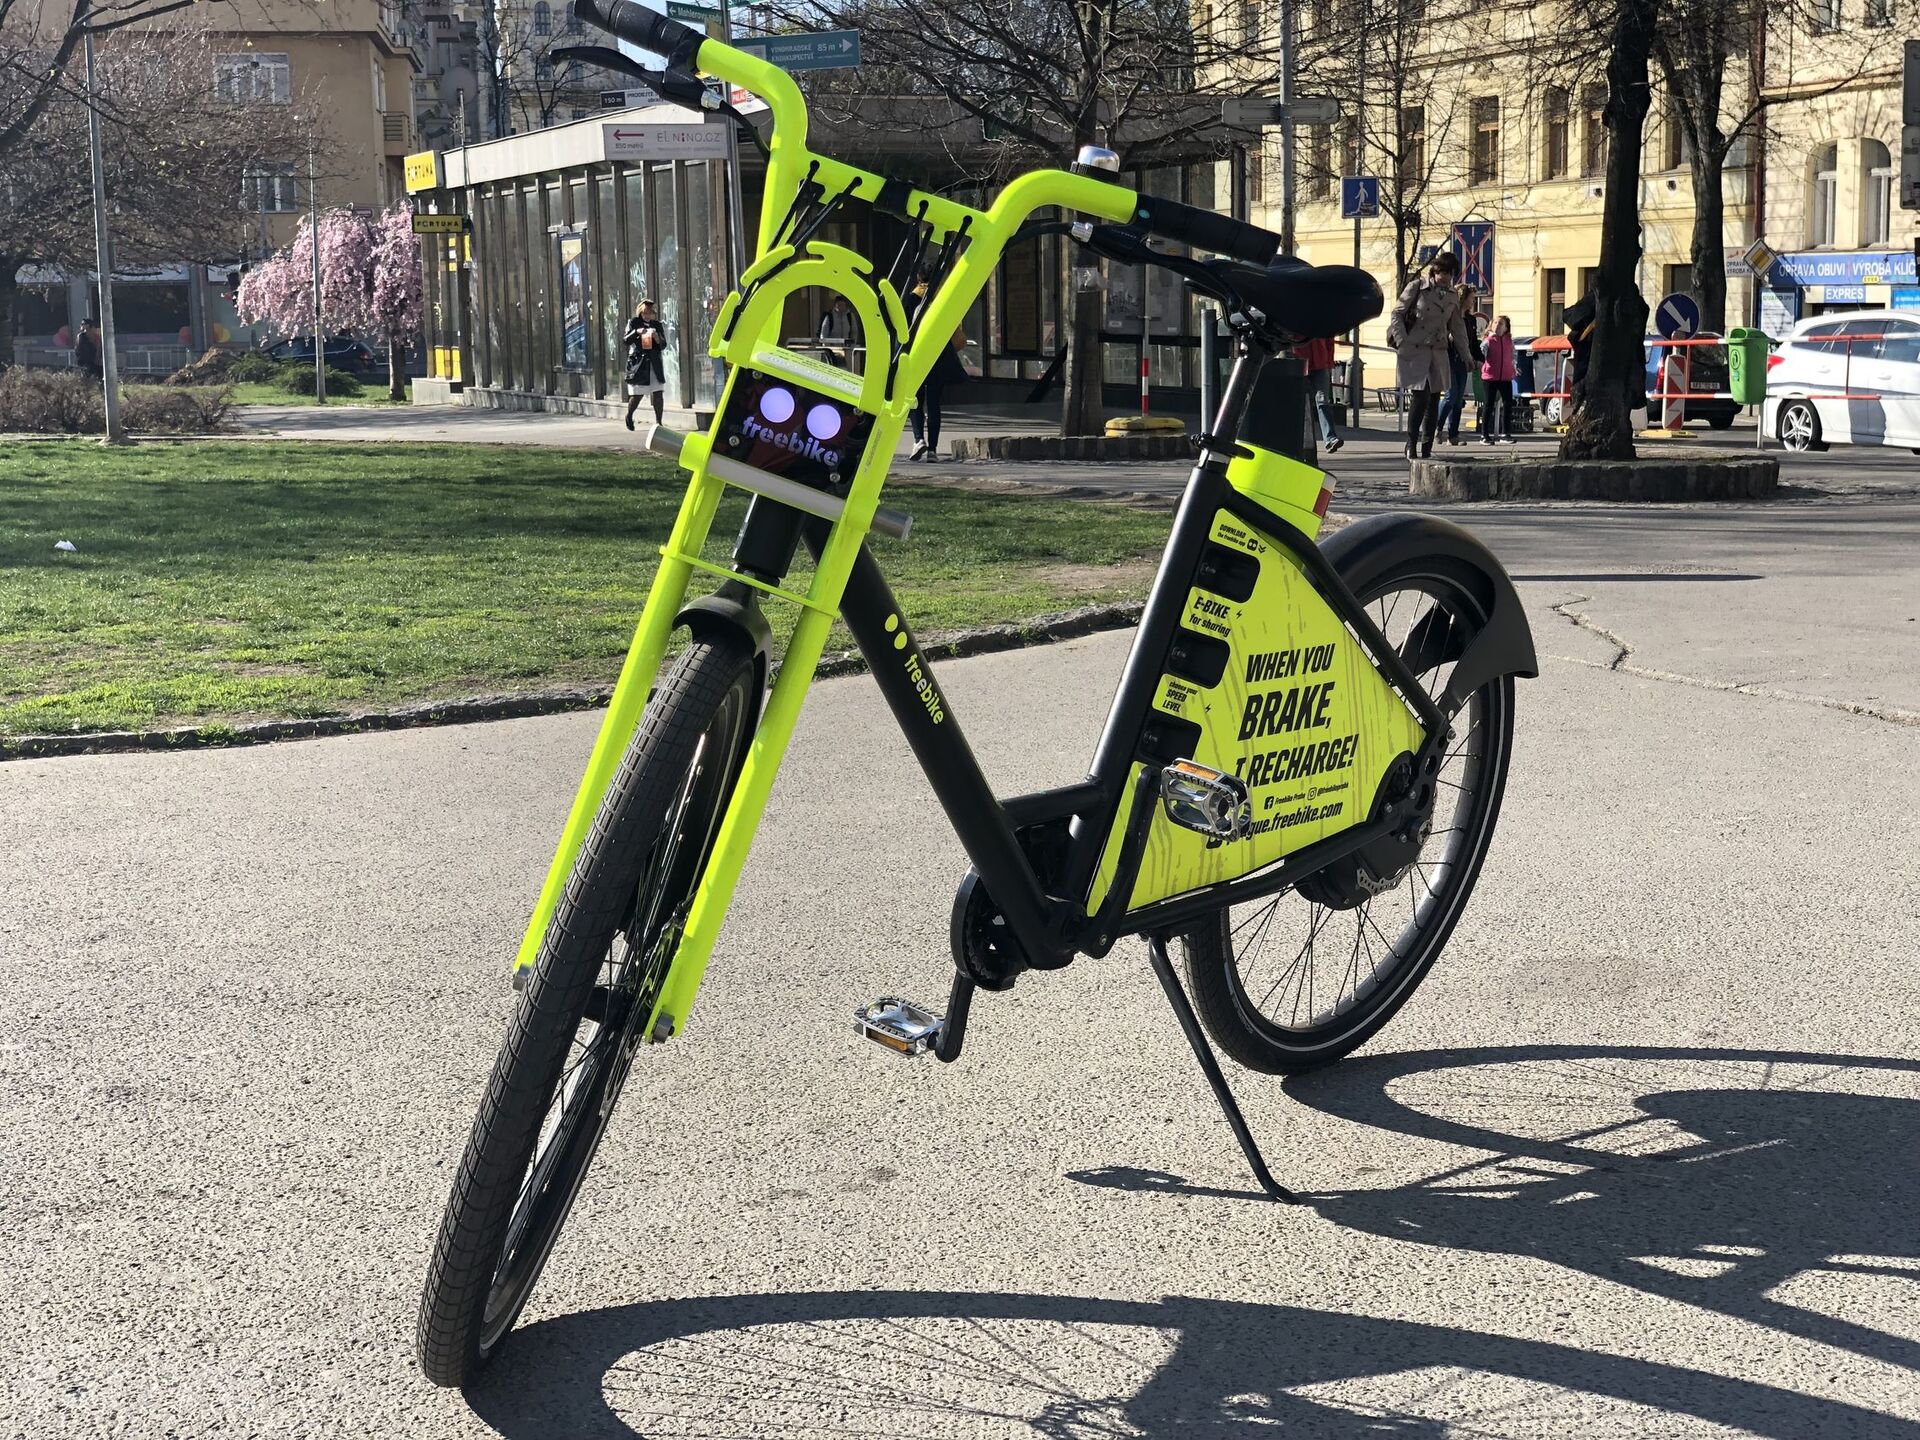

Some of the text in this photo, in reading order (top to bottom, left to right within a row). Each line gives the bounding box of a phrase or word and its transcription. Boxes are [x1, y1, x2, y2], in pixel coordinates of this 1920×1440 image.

[817, 43, 827, 52] 85
[1778, 262, 1816, 277] OPRAVA
[1817, 262, 1846, 277] OBUVI
[1852, 260, 1892, 276] VÝROBA
[1825, 287, 1864, 300] EXPRES
[741, 416, 840, 467] freebike
[1193, 596, 1231, 619] E-BIKE
[1189, 613, 1231, 638] for sharing
[1245, 643, 1336, 683] WHEN YOU
[904, 653, 944, 725] freebike
[1165, 688, 1188, 703] SPEED
[1162, 699, 1182, 713] LEVEL
[1237, 681, 1336, 741] BRAKE,
[1246, 733, 1360, 789] RECHARGE!
